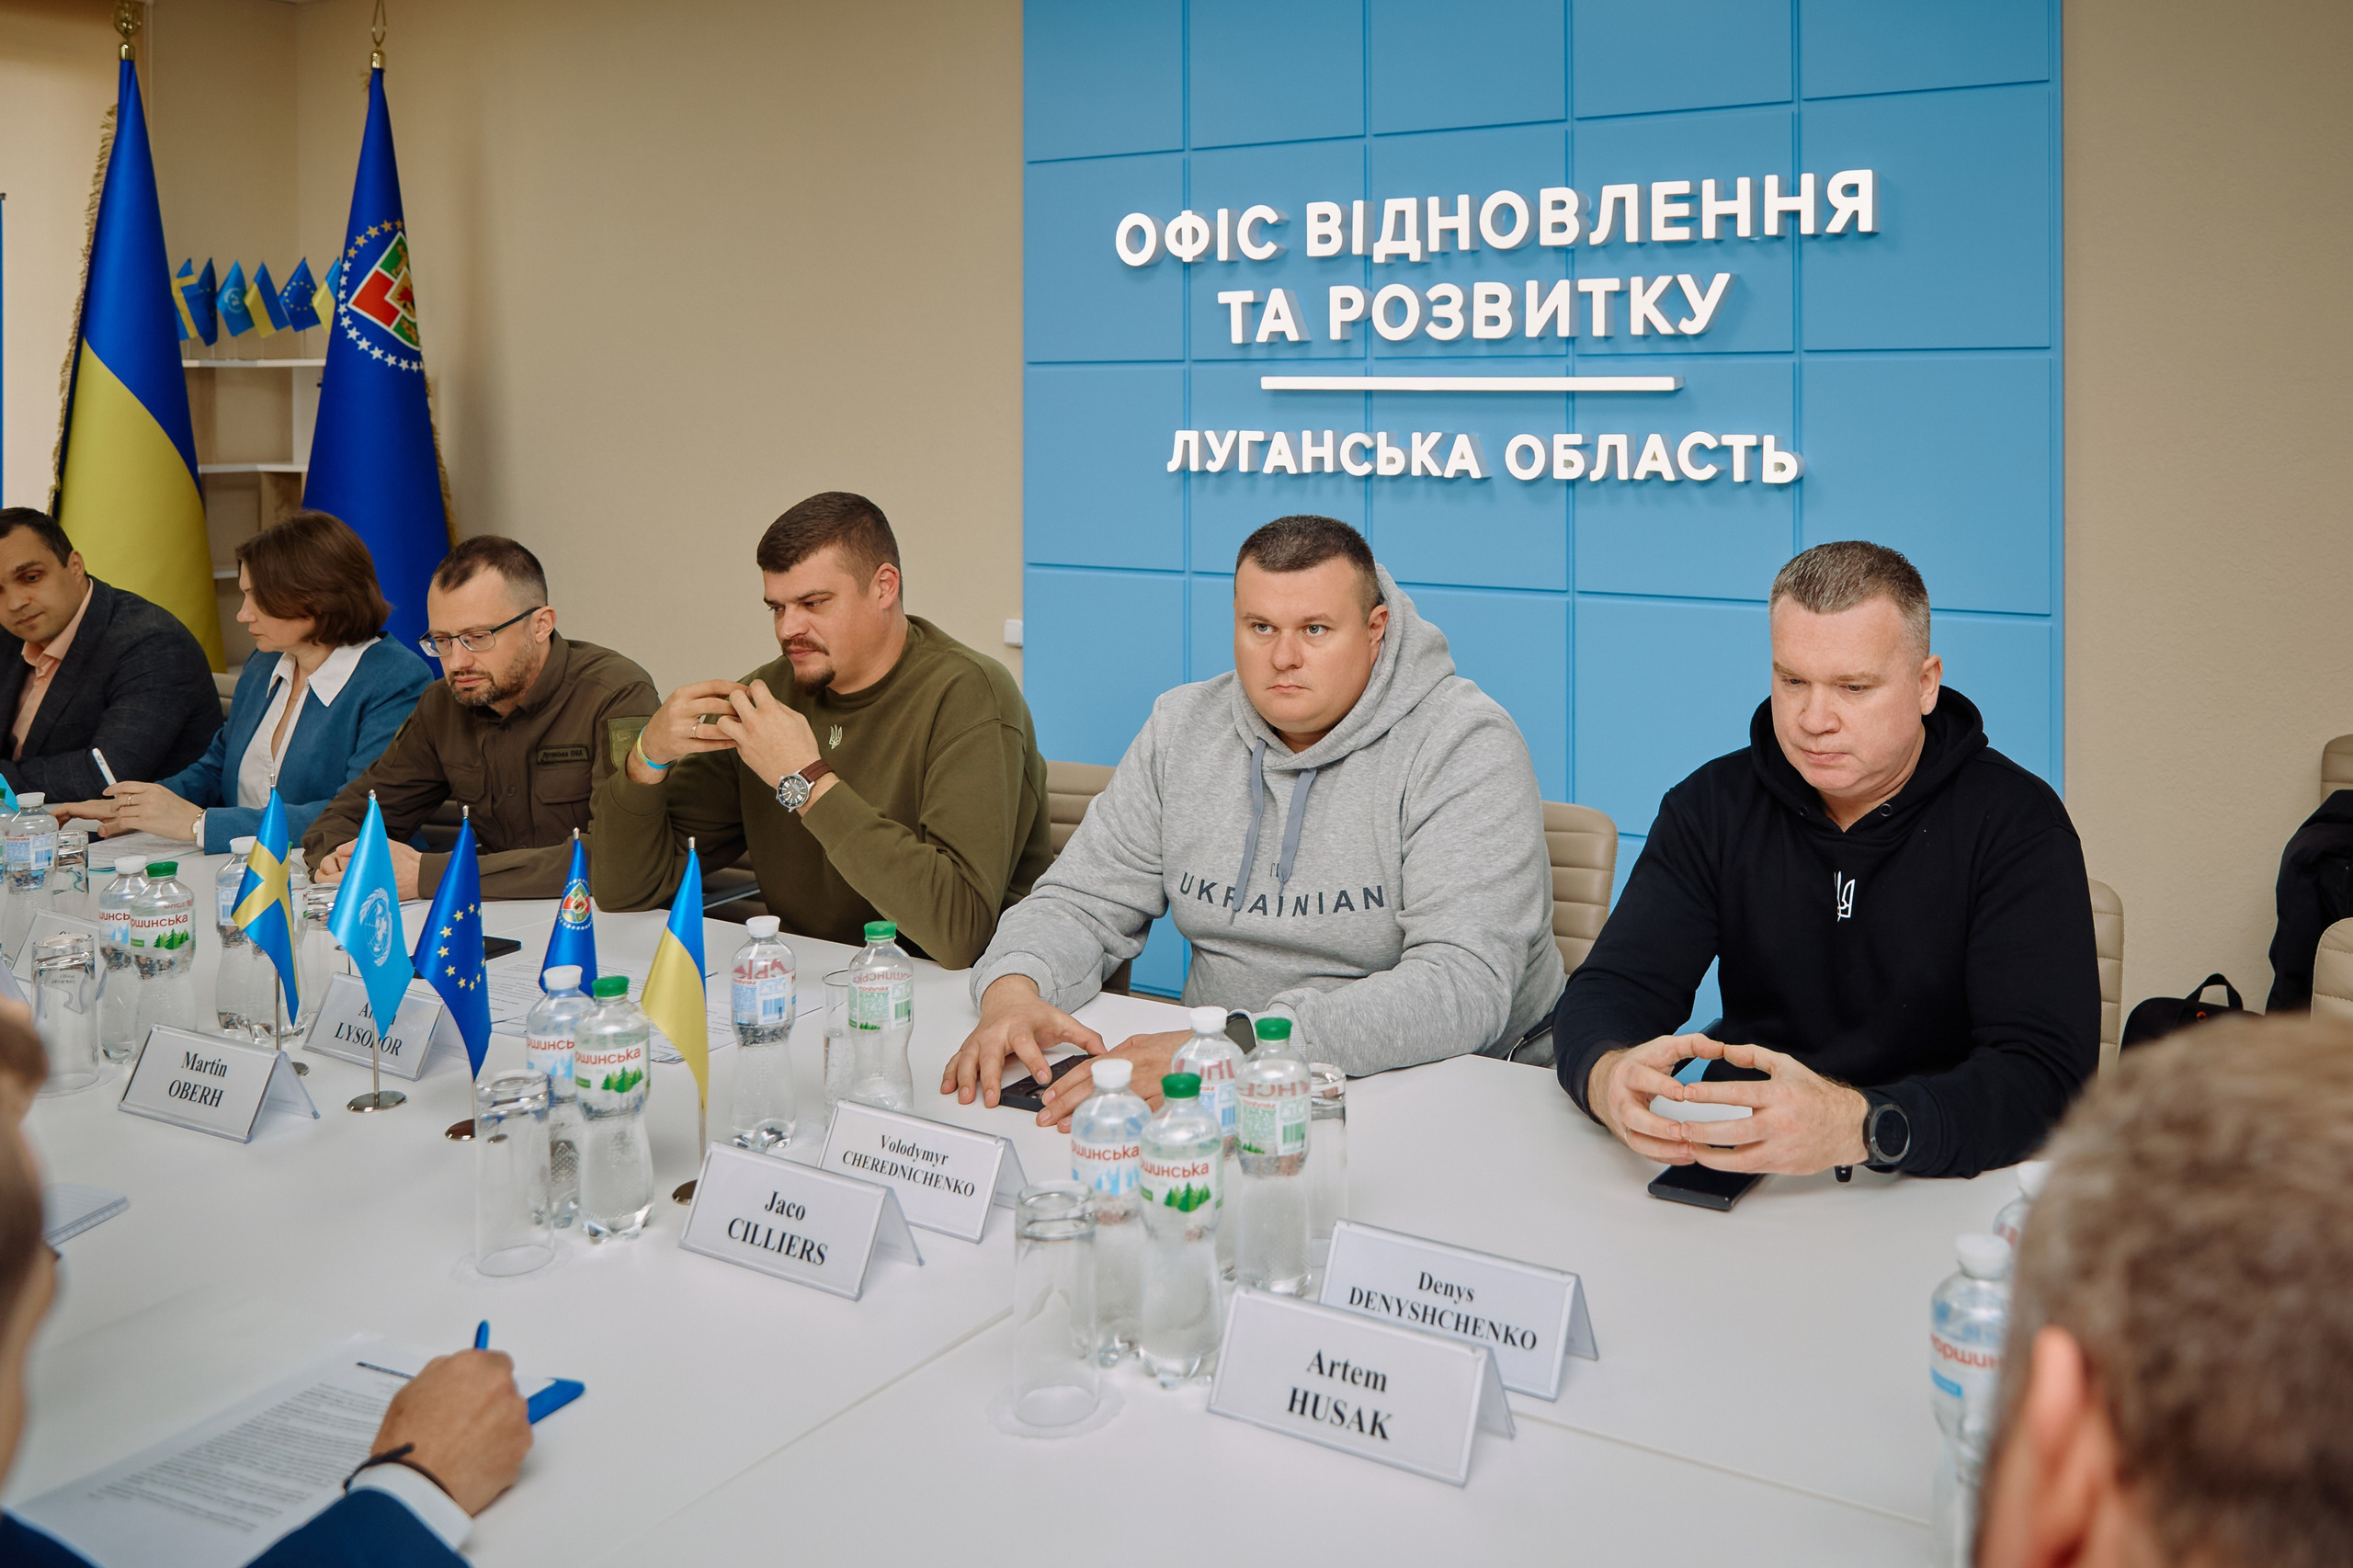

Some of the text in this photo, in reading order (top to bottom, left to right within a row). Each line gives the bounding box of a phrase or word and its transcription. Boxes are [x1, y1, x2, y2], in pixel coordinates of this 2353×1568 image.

[1115, 169, 1873, 267] ОФІС ВІДНОВЛЕННЯ
[1217, 273, 1732, 344] ТА РОЗВИТКУ
[1166, 429, 1799, 483] ЛУГАНСЬКА ОБЛАСТЬ
[181, 1051, 228, 1078] Martin
[168, 1079, 224, 1108] OBERH
[842, 1150, 976, 1198] CHEREDNICHENKO
[881, 1134, 949, 1168] Volodymyr
[764, 1190, 806, 1221] Jaco
[727, 1217, 828, 1266] CILLIERS
[1417, 1271, 1475, 1304] Denys
[1348, 1286, 1538, 1350] DENYSHCHENKO
[1306, 1348, 1387, 1392] Artem
[1287, 1385, 1393, 1441] HUSAK
